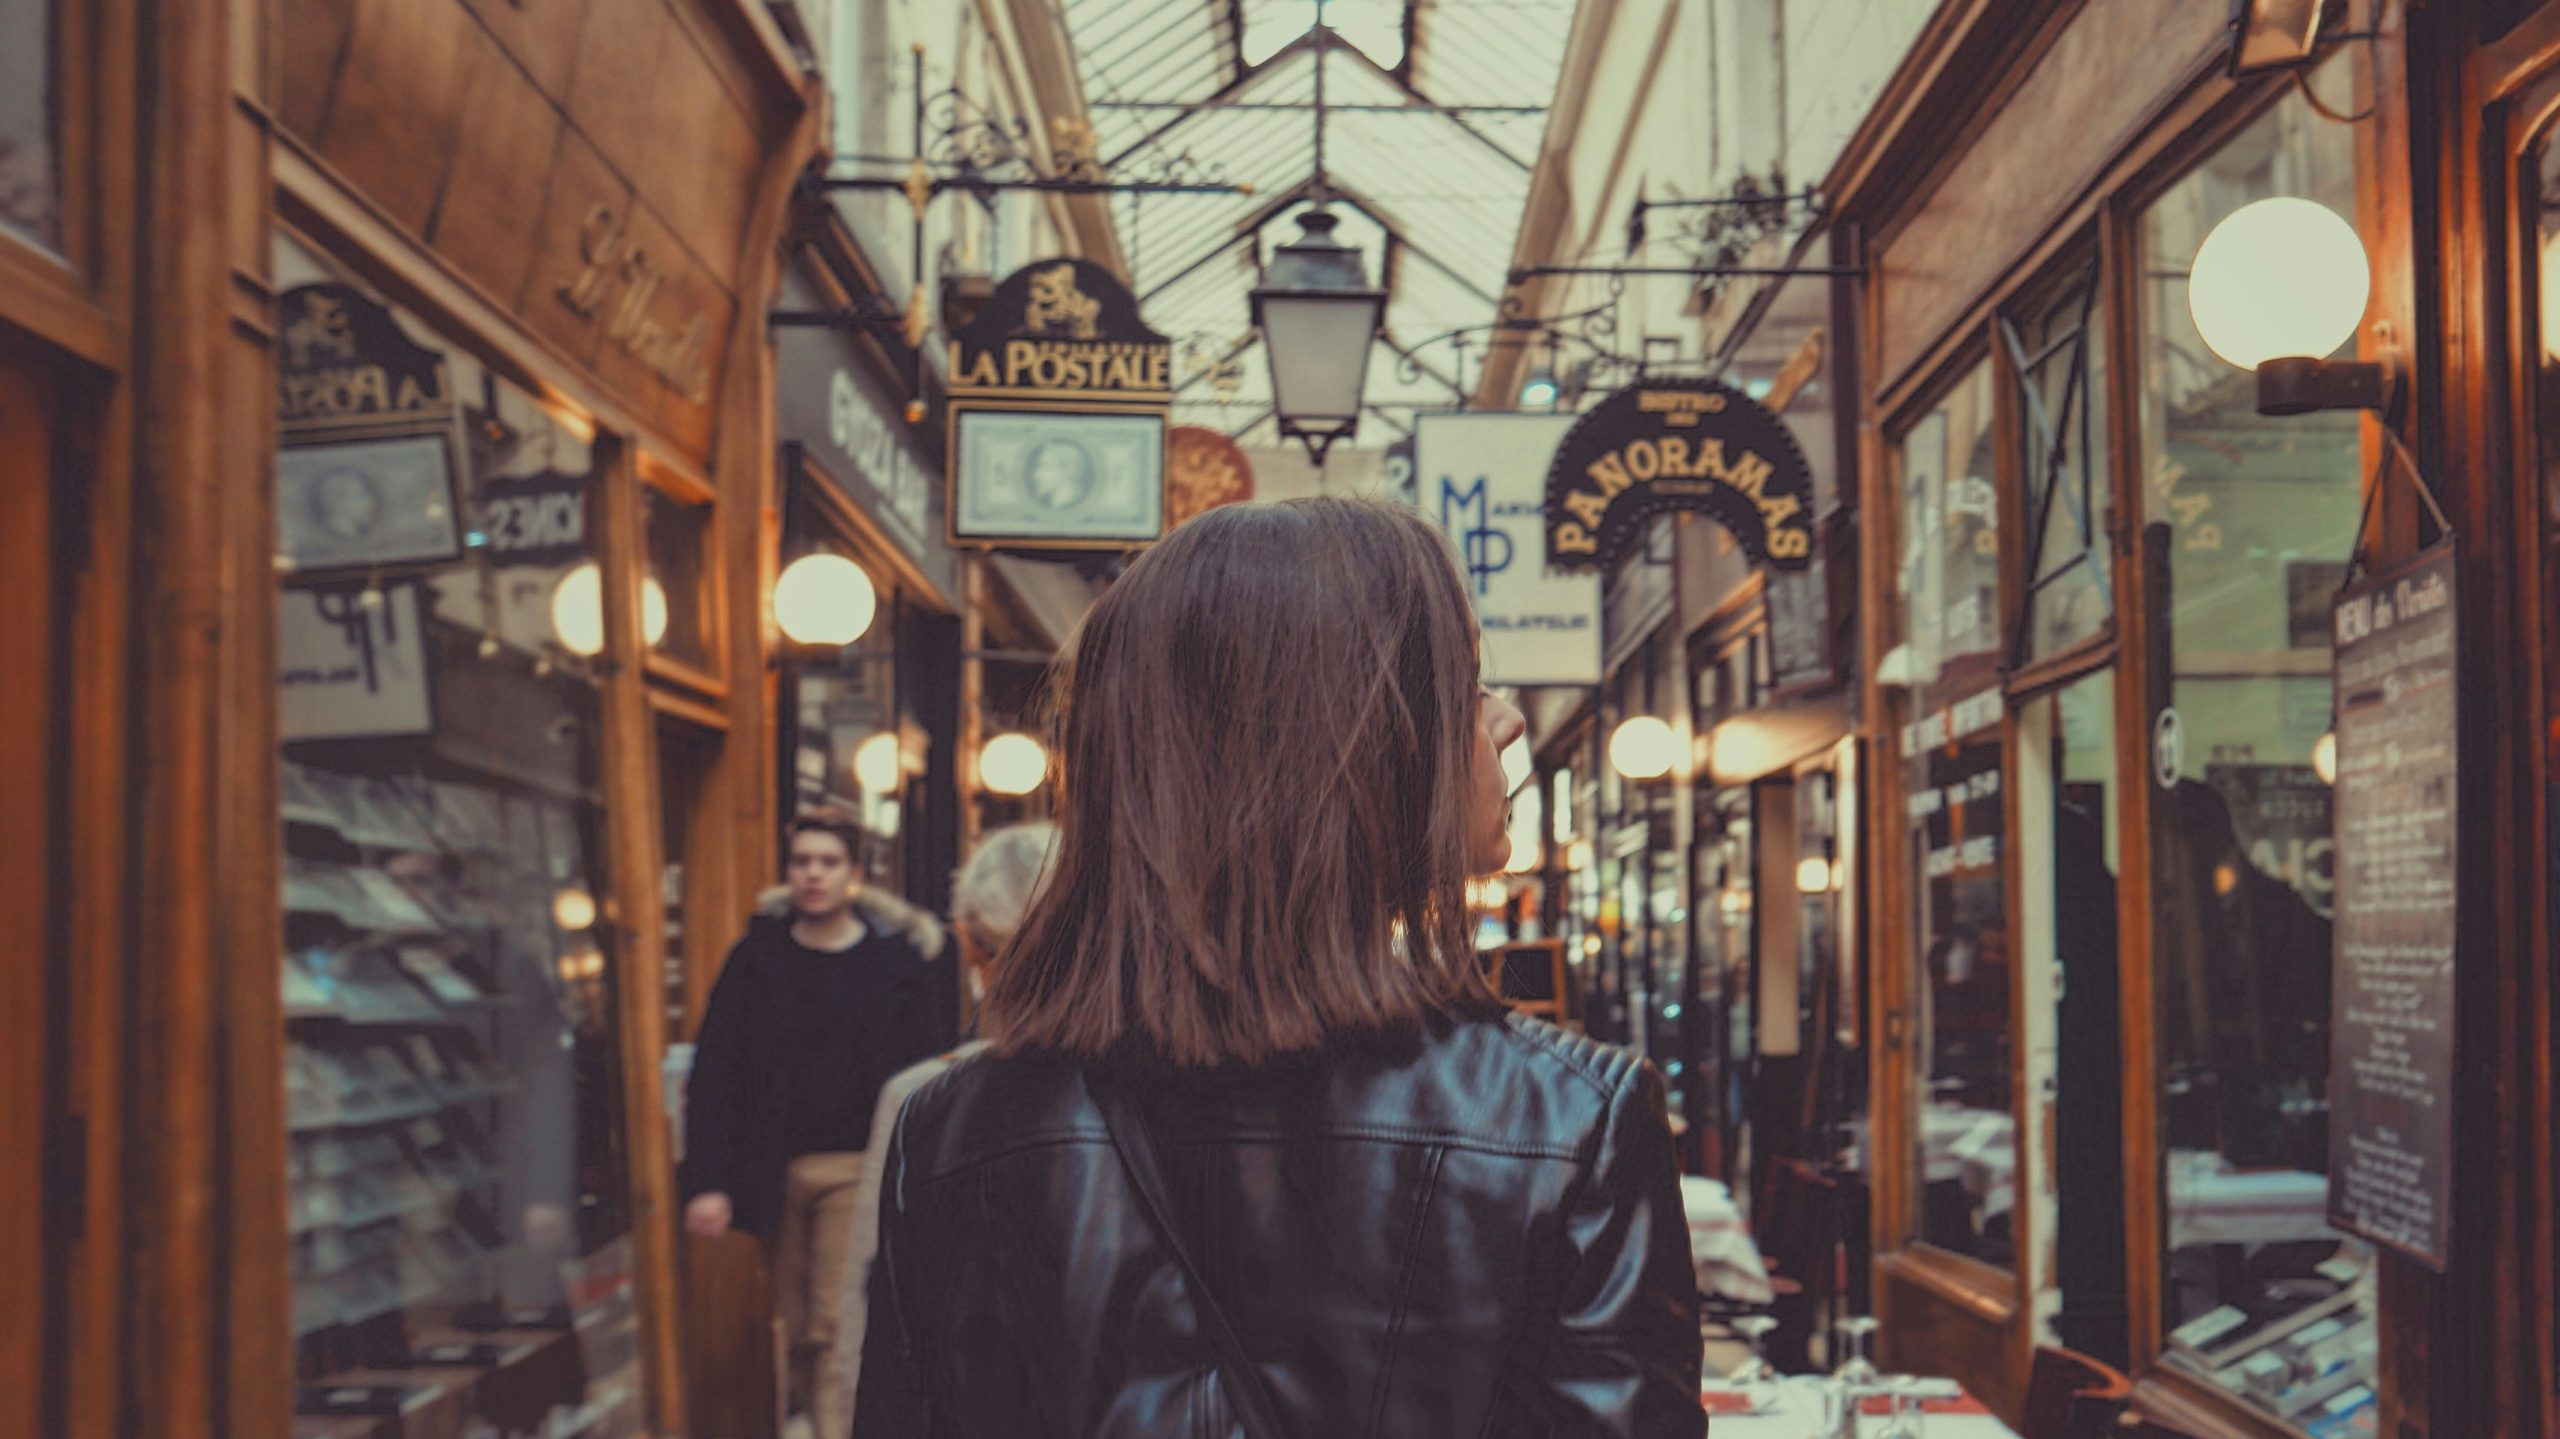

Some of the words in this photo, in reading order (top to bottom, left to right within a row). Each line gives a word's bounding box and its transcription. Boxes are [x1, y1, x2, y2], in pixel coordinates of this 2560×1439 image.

[949, 342, 1000, 387] LA
[1005, 341, 1169, 388] POSTALE
[1554, 435, 1809, 559] PANORAMAS
